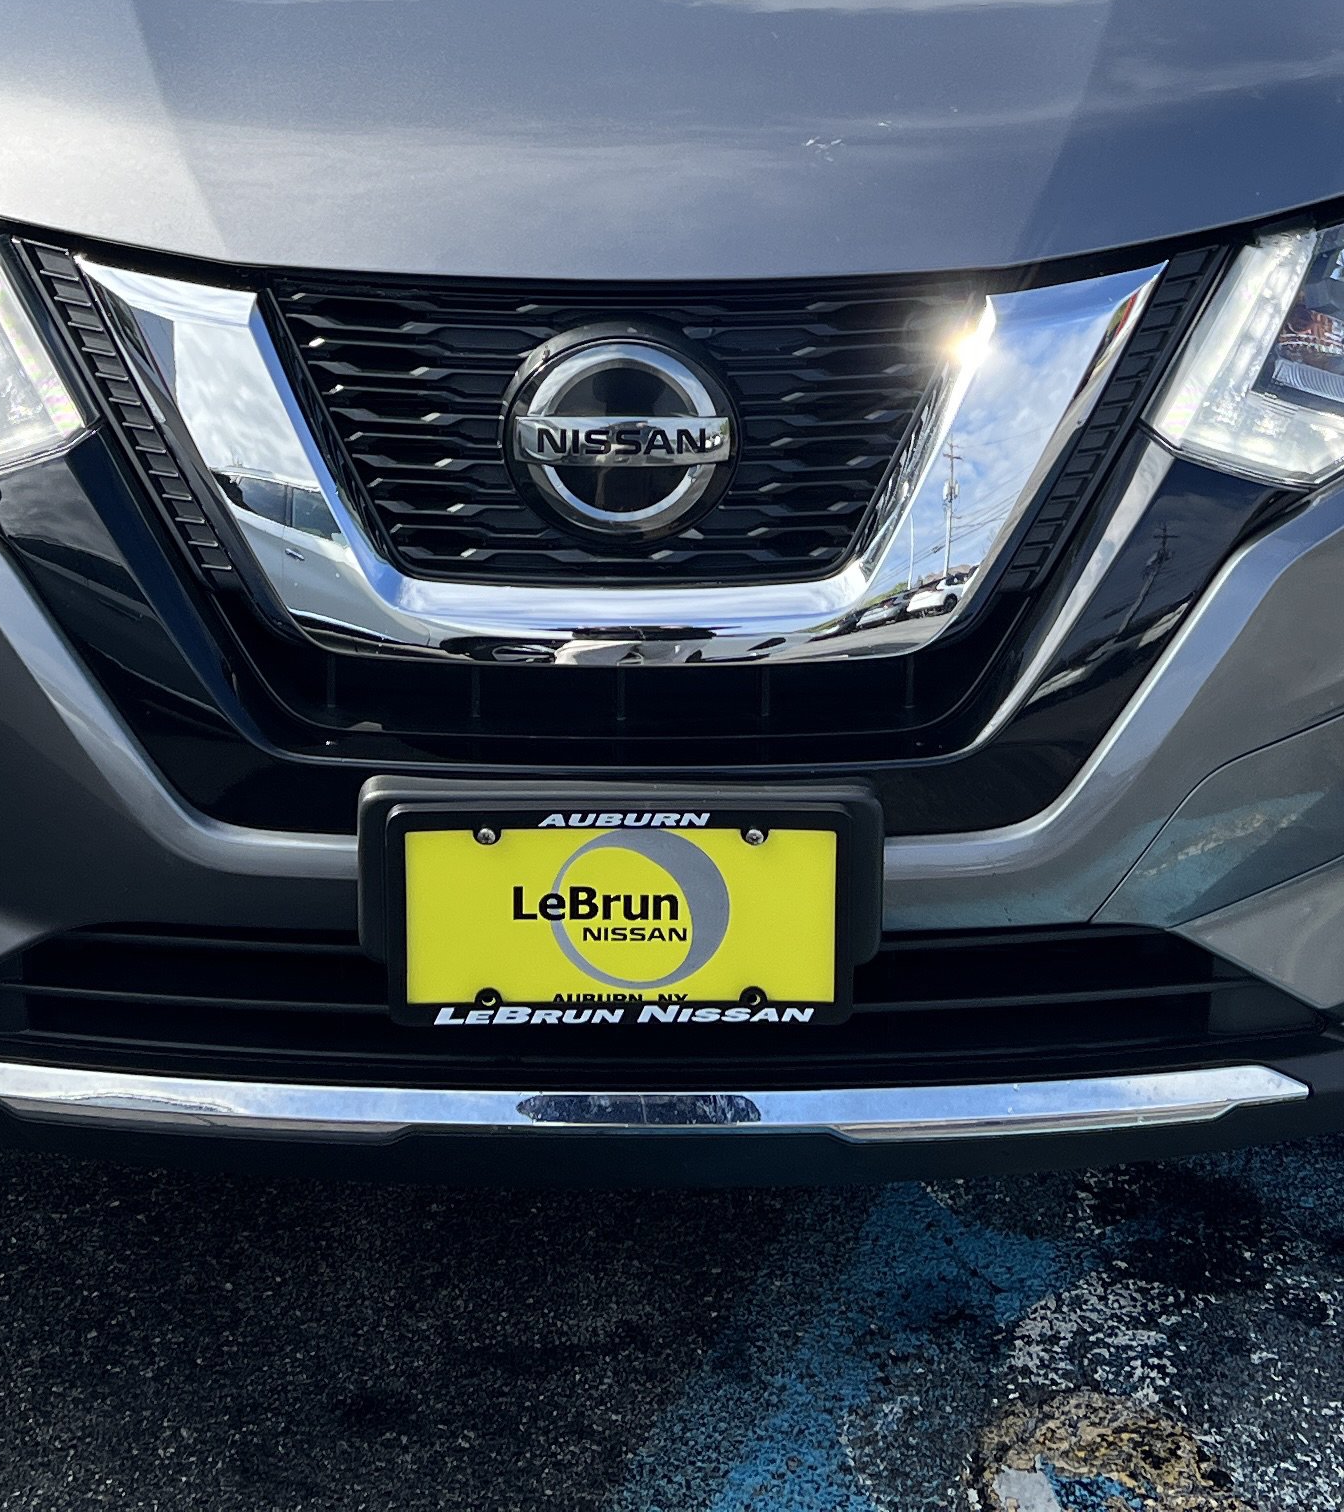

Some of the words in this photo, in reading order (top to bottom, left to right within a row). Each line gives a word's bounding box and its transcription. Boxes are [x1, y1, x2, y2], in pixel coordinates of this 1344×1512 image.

[536, 427, 707, 455] NISSAN
[538, 812, 711, 828] AUBURN
[512, 886, 680, 922] LeBrun
[582, 926, 689, 943] NISSAN
